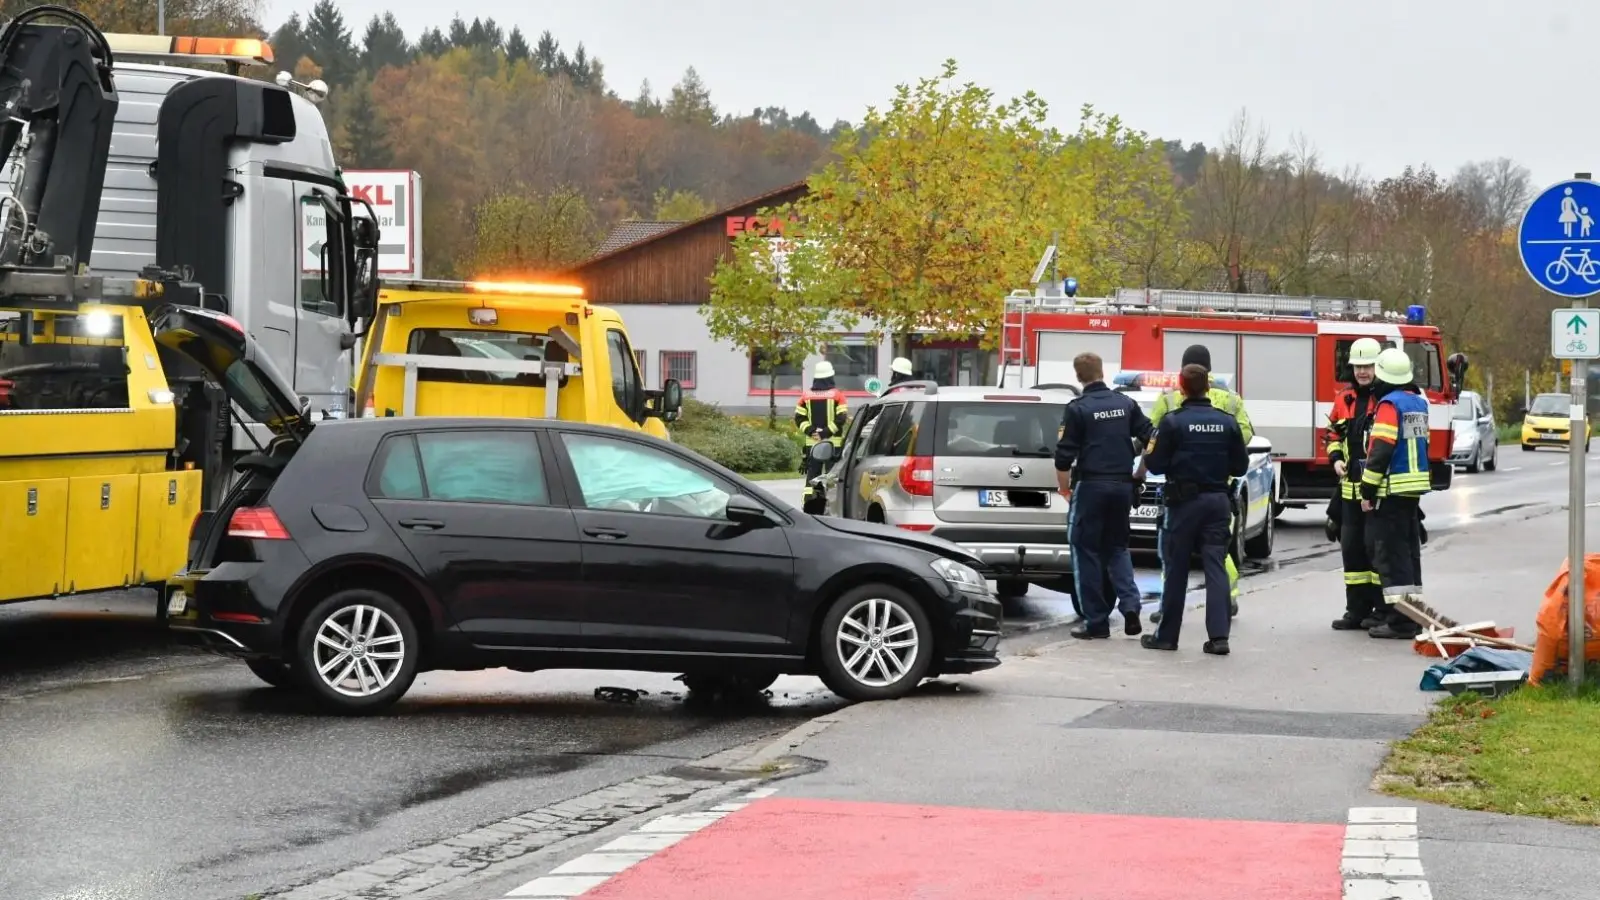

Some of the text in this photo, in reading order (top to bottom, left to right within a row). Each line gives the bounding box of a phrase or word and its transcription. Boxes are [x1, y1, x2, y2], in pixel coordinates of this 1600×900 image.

[306, 214, 394, 227] Kam lar
[1145, 374, 1180, 388] UNFA
[1093, 409, 1125, 420] POLIZEI
[1189, 424, 1224, 433] POLIZEI
[987, 491, 1003, 503] AS
